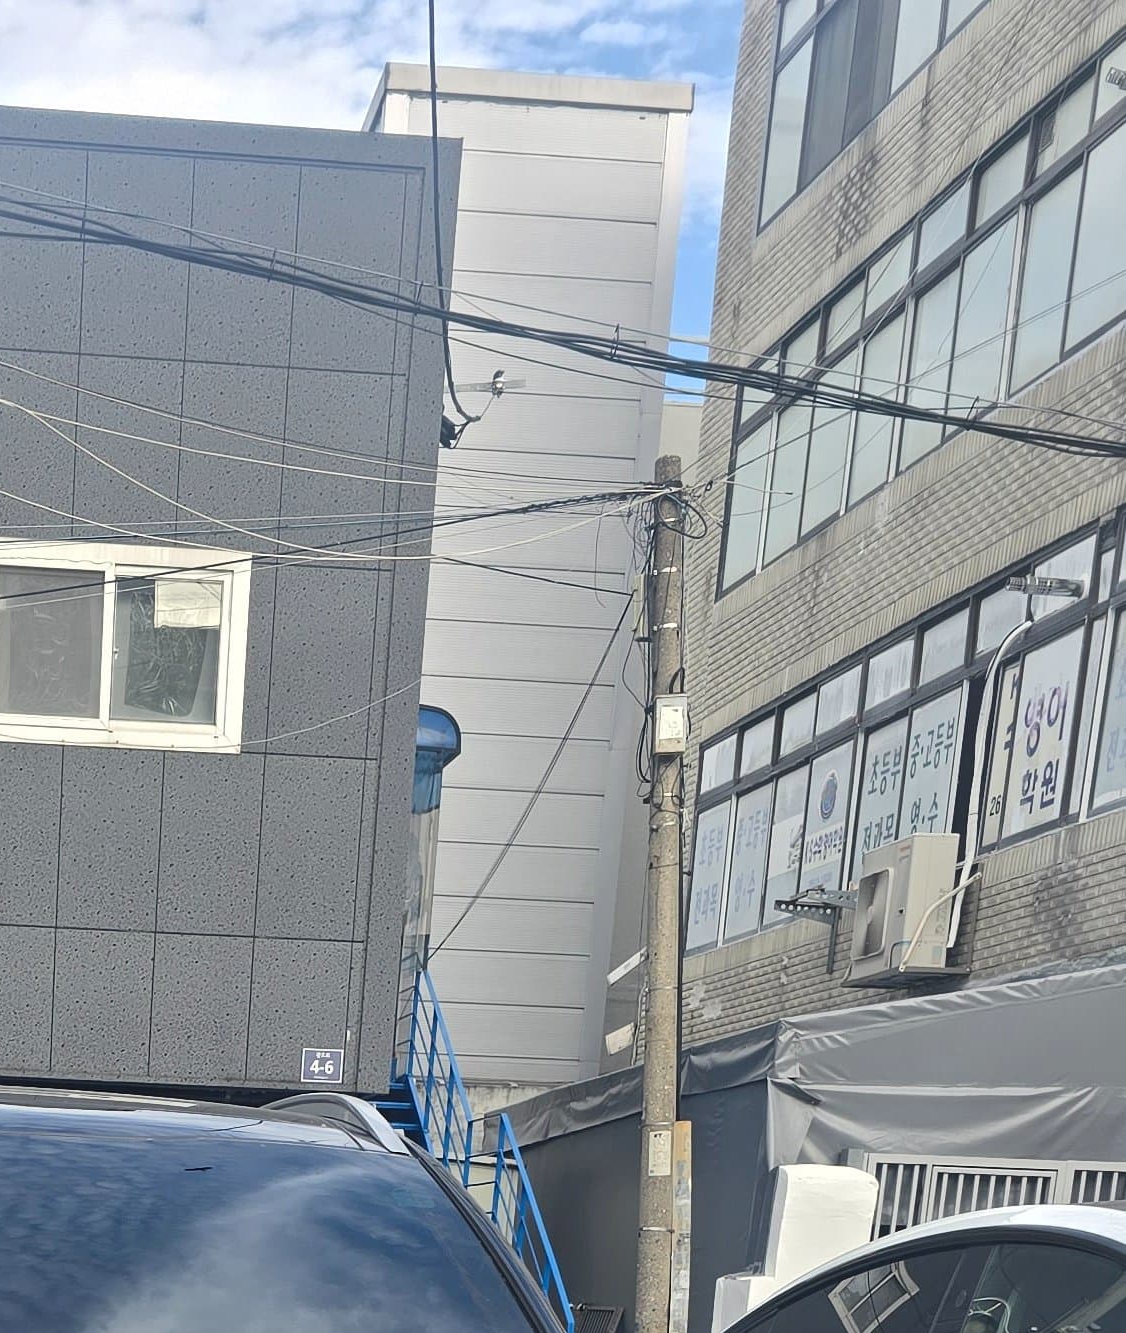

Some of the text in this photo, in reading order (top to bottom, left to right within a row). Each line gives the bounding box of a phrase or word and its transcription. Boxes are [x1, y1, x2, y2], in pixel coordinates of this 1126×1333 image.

[1024, 681, 1070, 757] 영어
[867, 745, 902, 795] 초등부
[1019, 758, 1060, 815] 학원
[309, 1059, 334, 1075] 4-6
